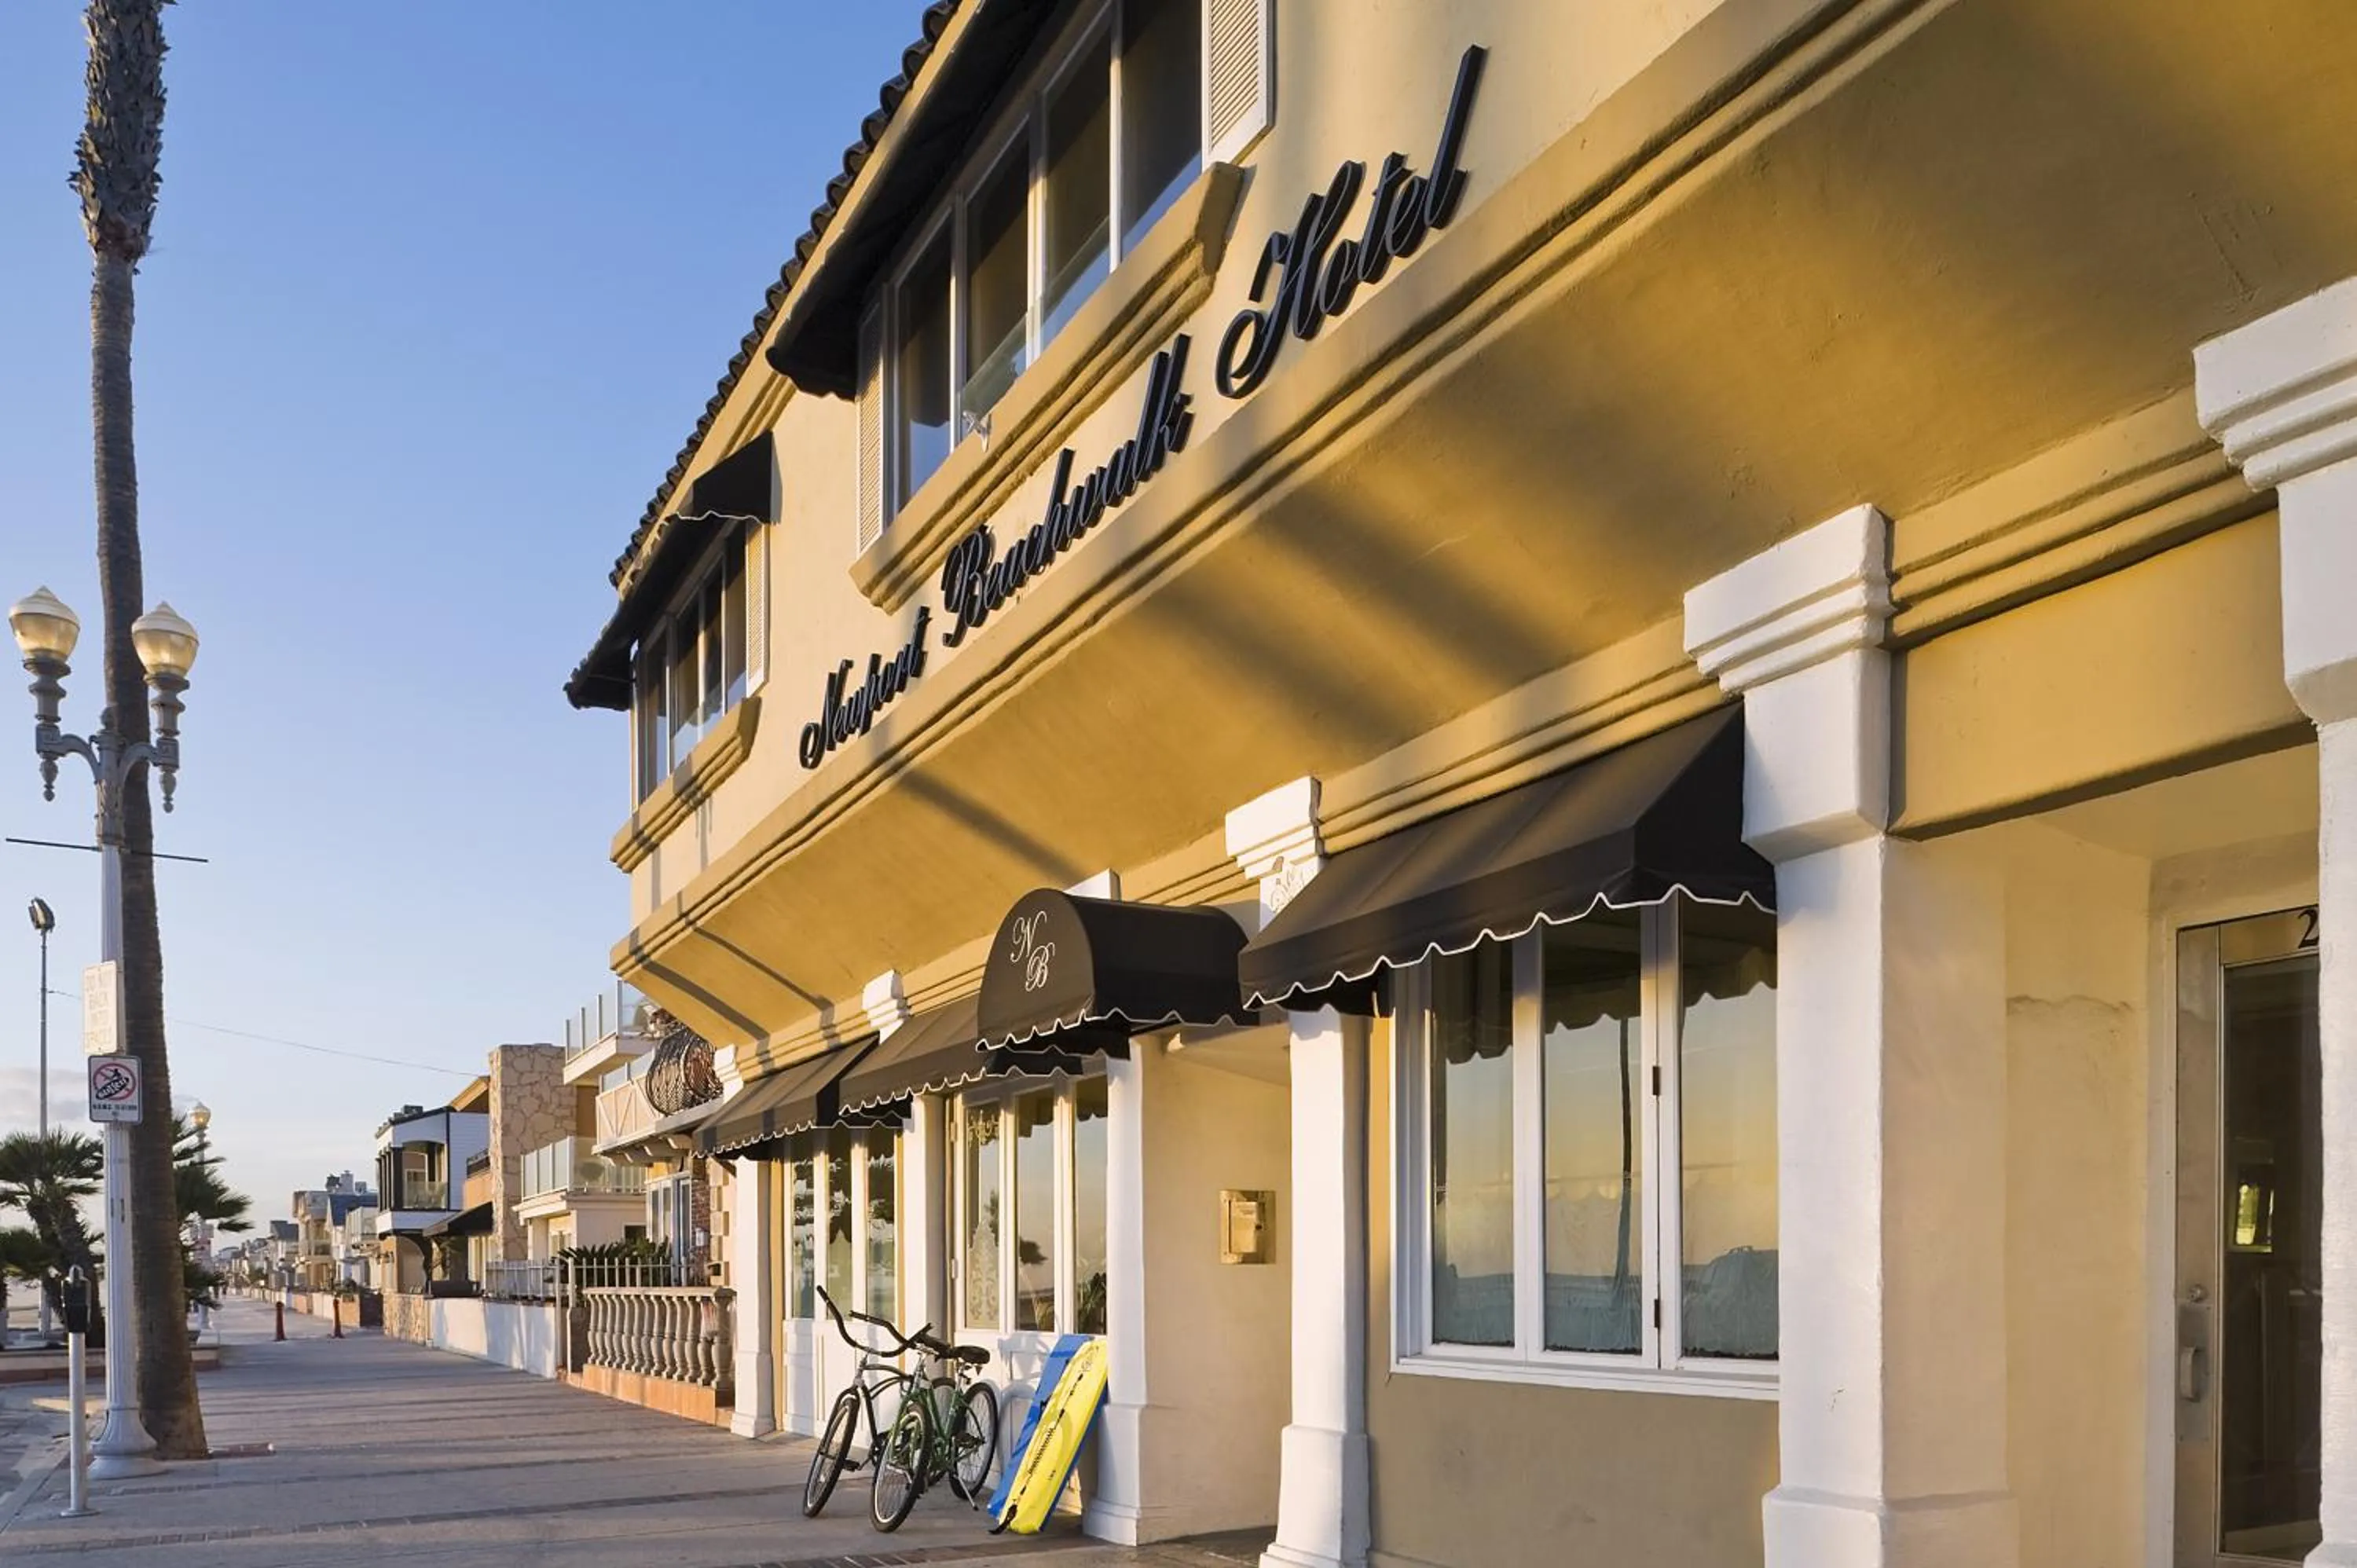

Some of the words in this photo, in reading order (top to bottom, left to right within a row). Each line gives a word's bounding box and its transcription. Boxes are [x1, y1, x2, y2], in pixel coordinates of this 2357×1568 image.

[800, 606, 932, 769] Newport
[941, 333, 1195, 647] Beachwalk
[1215, 44, 1487, 399] Hotel
